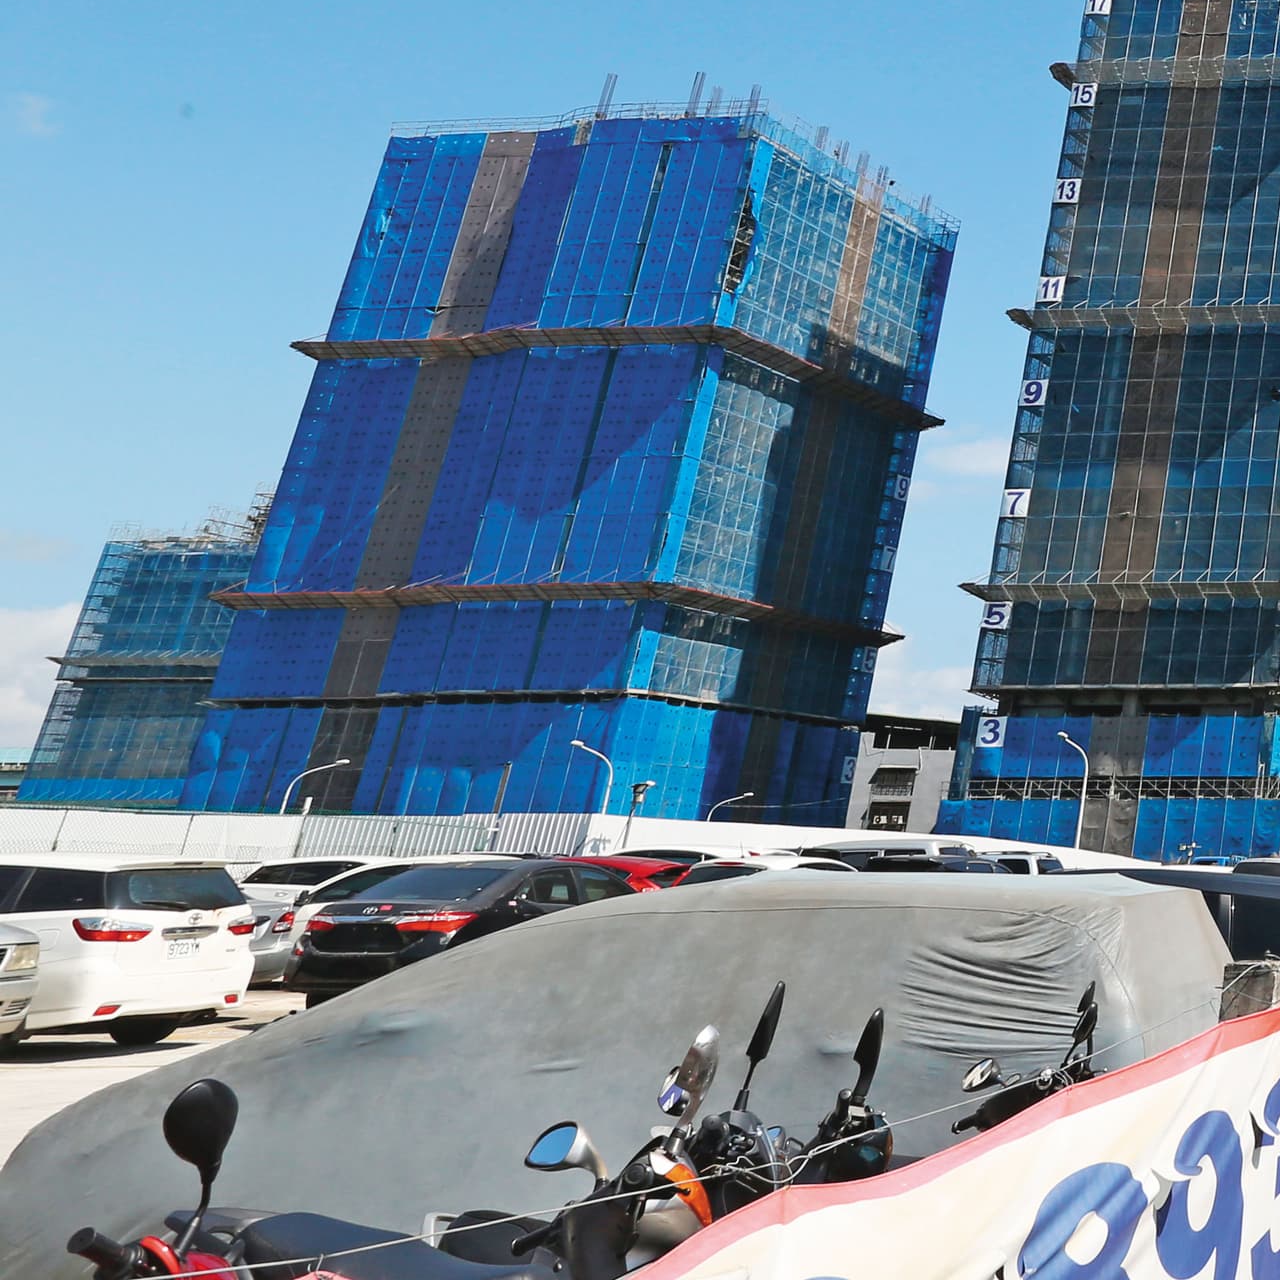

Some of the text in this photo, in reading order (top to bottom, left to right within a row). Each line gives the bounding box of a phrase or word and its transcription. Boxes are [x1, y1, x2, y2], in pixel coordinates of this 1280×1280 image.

[1072, 85, 1093, 104] 15
[1057, 181, 1076, 200] 13
[1041, 279, 1060, 299] 11
[1023, 381, 1043, 404] 9
[898, 478, 908, 499] 9
[1007, 492, 1025, 515] 7
[886, 549, 895, 568] 7
[983, 603, 1007, 626] 5
[864, 648, 877, 670] 5
[980, 718, 1001, 745] 3
